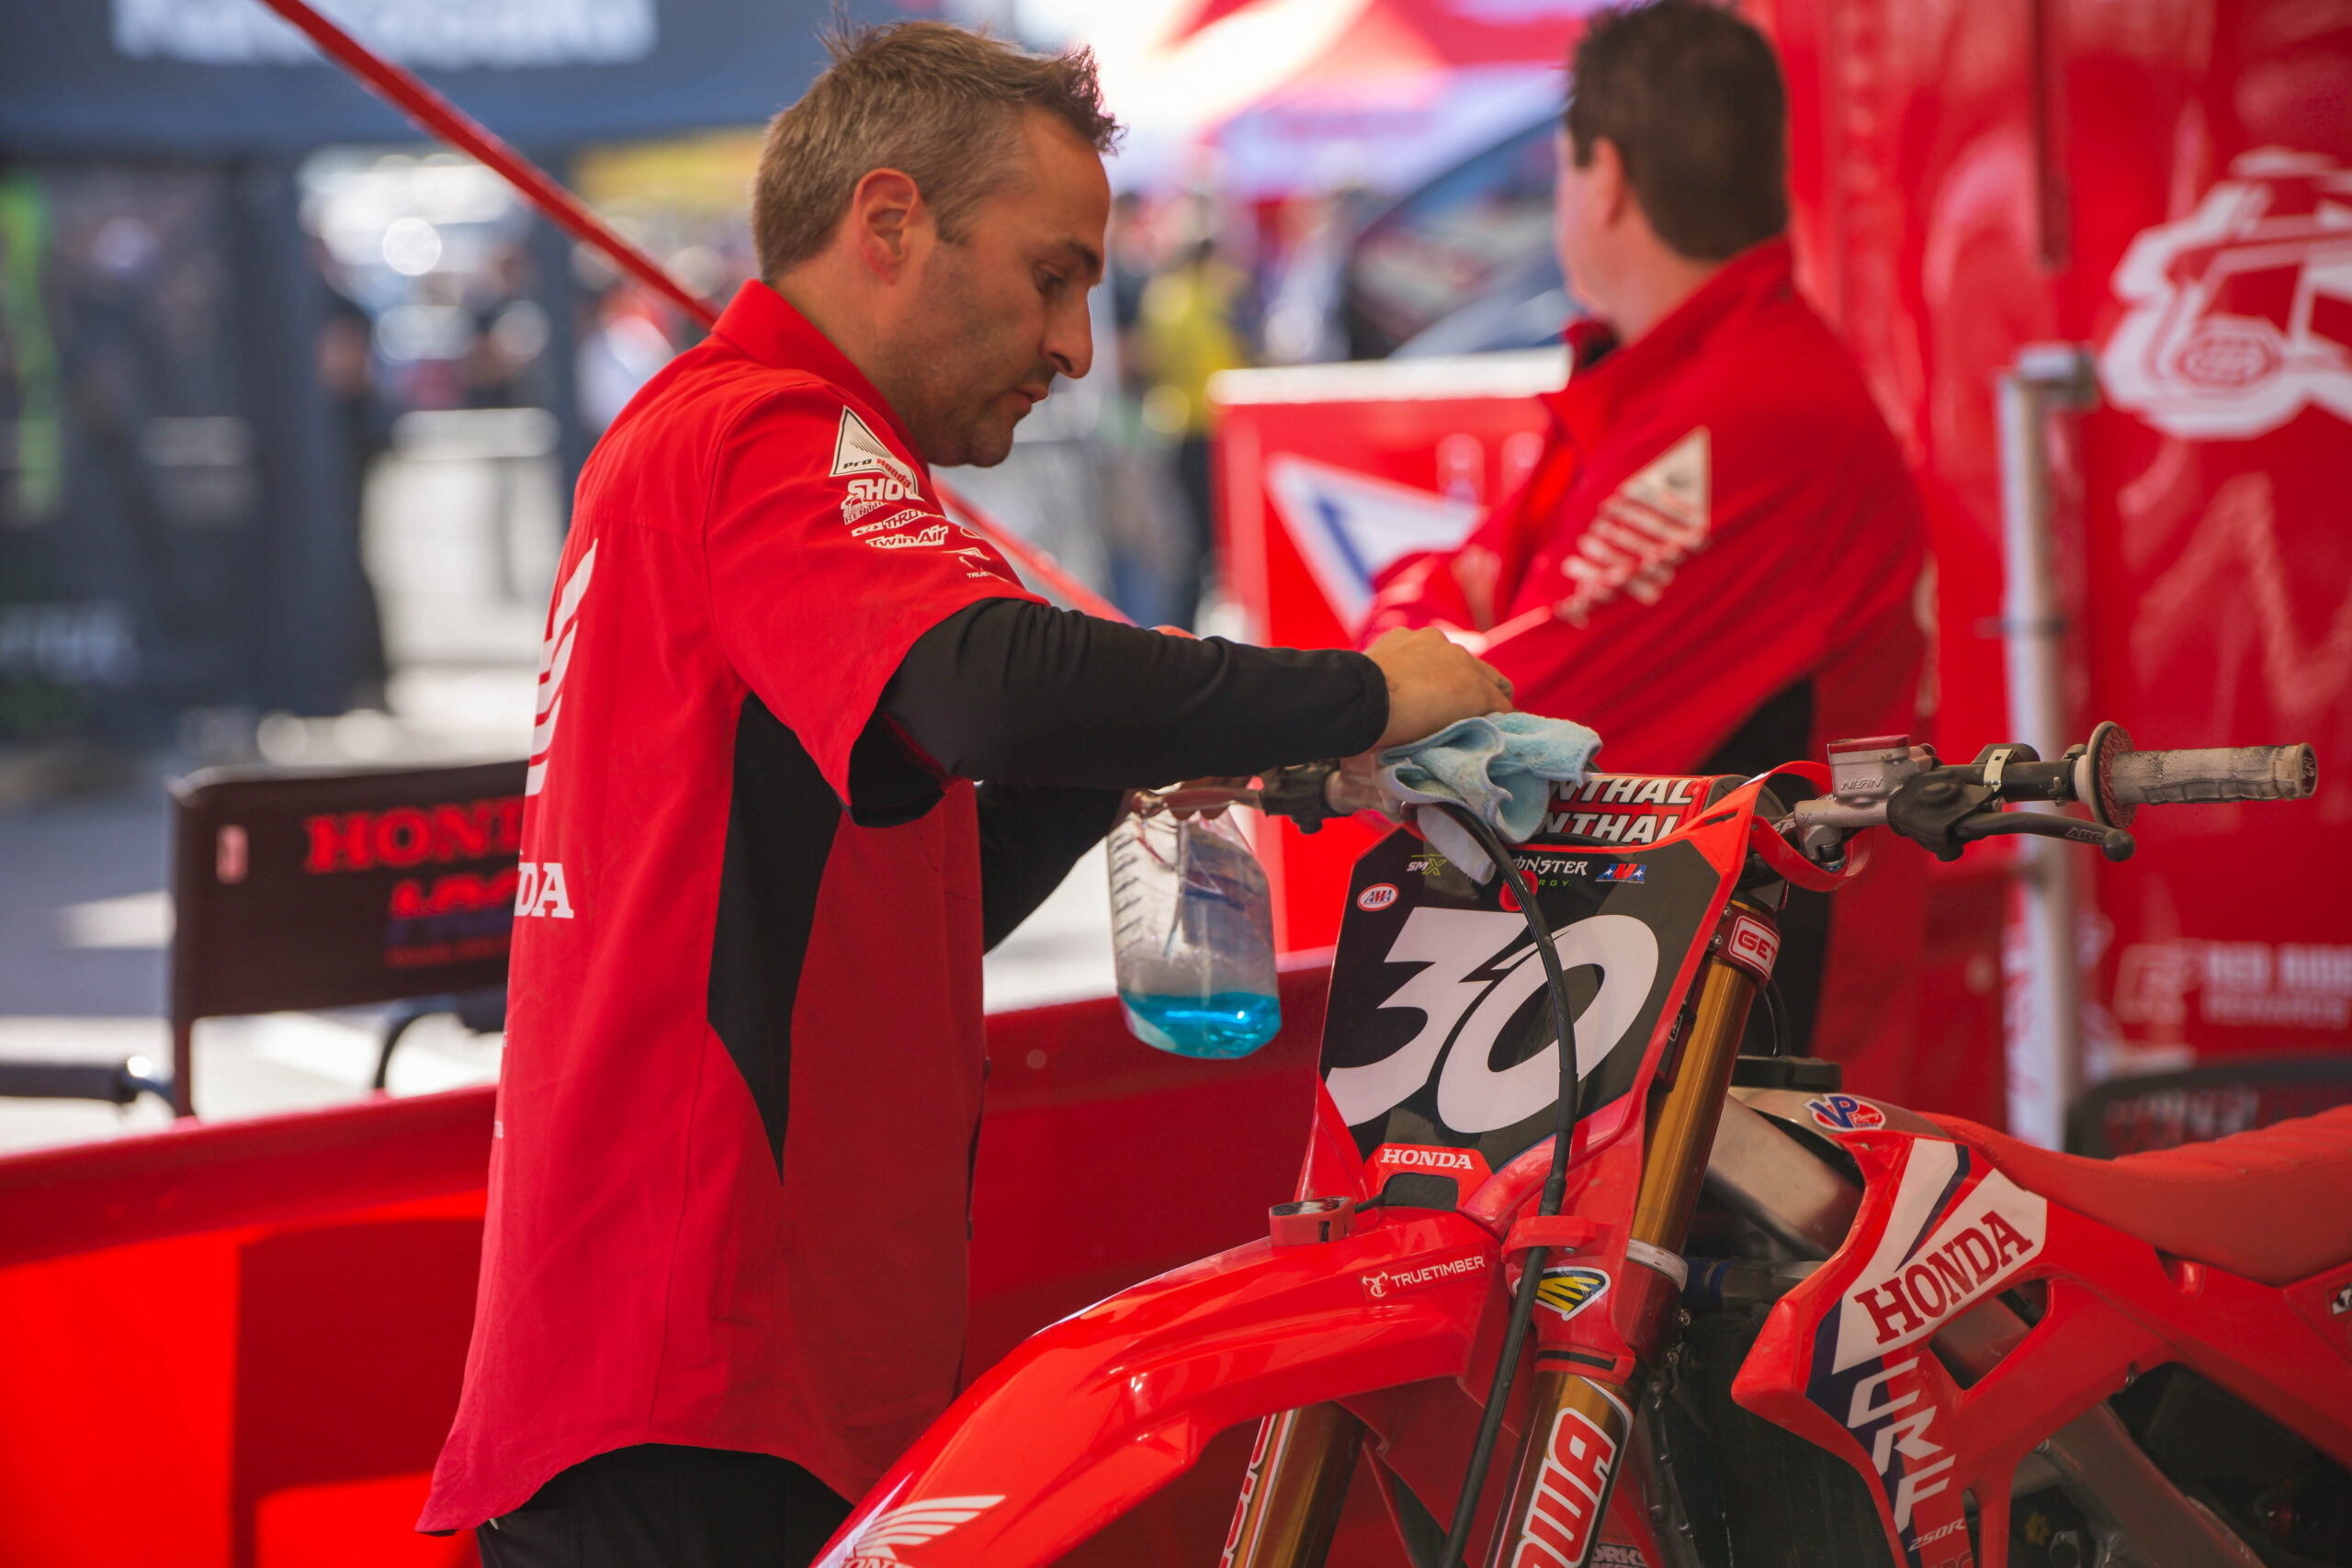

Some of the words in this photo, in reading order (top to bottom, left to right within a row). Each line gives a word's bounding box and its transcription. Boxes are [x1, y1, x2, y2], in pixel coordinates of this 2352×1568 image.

[967, 570, 994, 580] TRUE
[1406, 857, 1447, 876] SMX
[1512, 855, 1589, 876] ONSTER
[1538, 878, 1571, 887] RGY
[1595, 863, 1647, 880] AMA
[1737, 929, 1777, 966] GET
[1325, 906, 1659, 1134] 30
[1808, 1095, 1860, 1129] VP
[1380, 1148, 1474, 1170] HONDA
[1390, 1255, 1486, 1289] TRUETIMBER
[1853, 1210, 2034, 1346] HONDA
[1847, 1356, 1957, 1535] CRF
[1908, 1517, 1966, 1552] 250R
